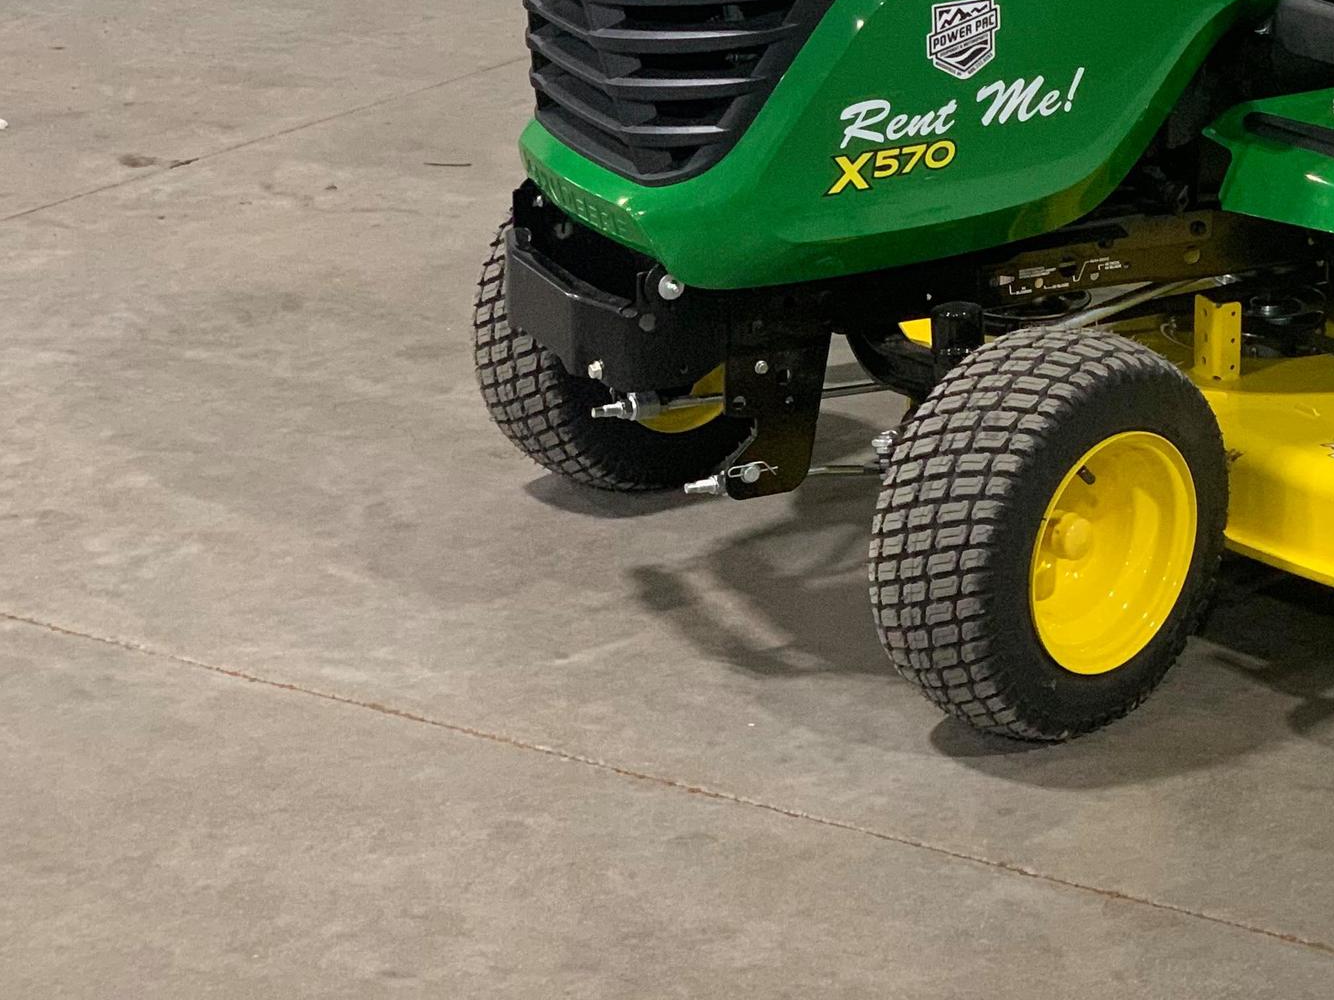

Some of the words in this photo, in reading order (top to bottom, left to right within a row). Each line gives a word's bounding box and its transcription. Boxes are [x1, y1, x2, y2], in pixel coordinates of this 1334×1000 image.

[933, 24, 972, 50] POWER
[975, 14, 995, 32] PAC
[839, 98, 958, 149] Rent
[975, 66, 1085, 127] Me!
[824, 140, 956, 197] X570
